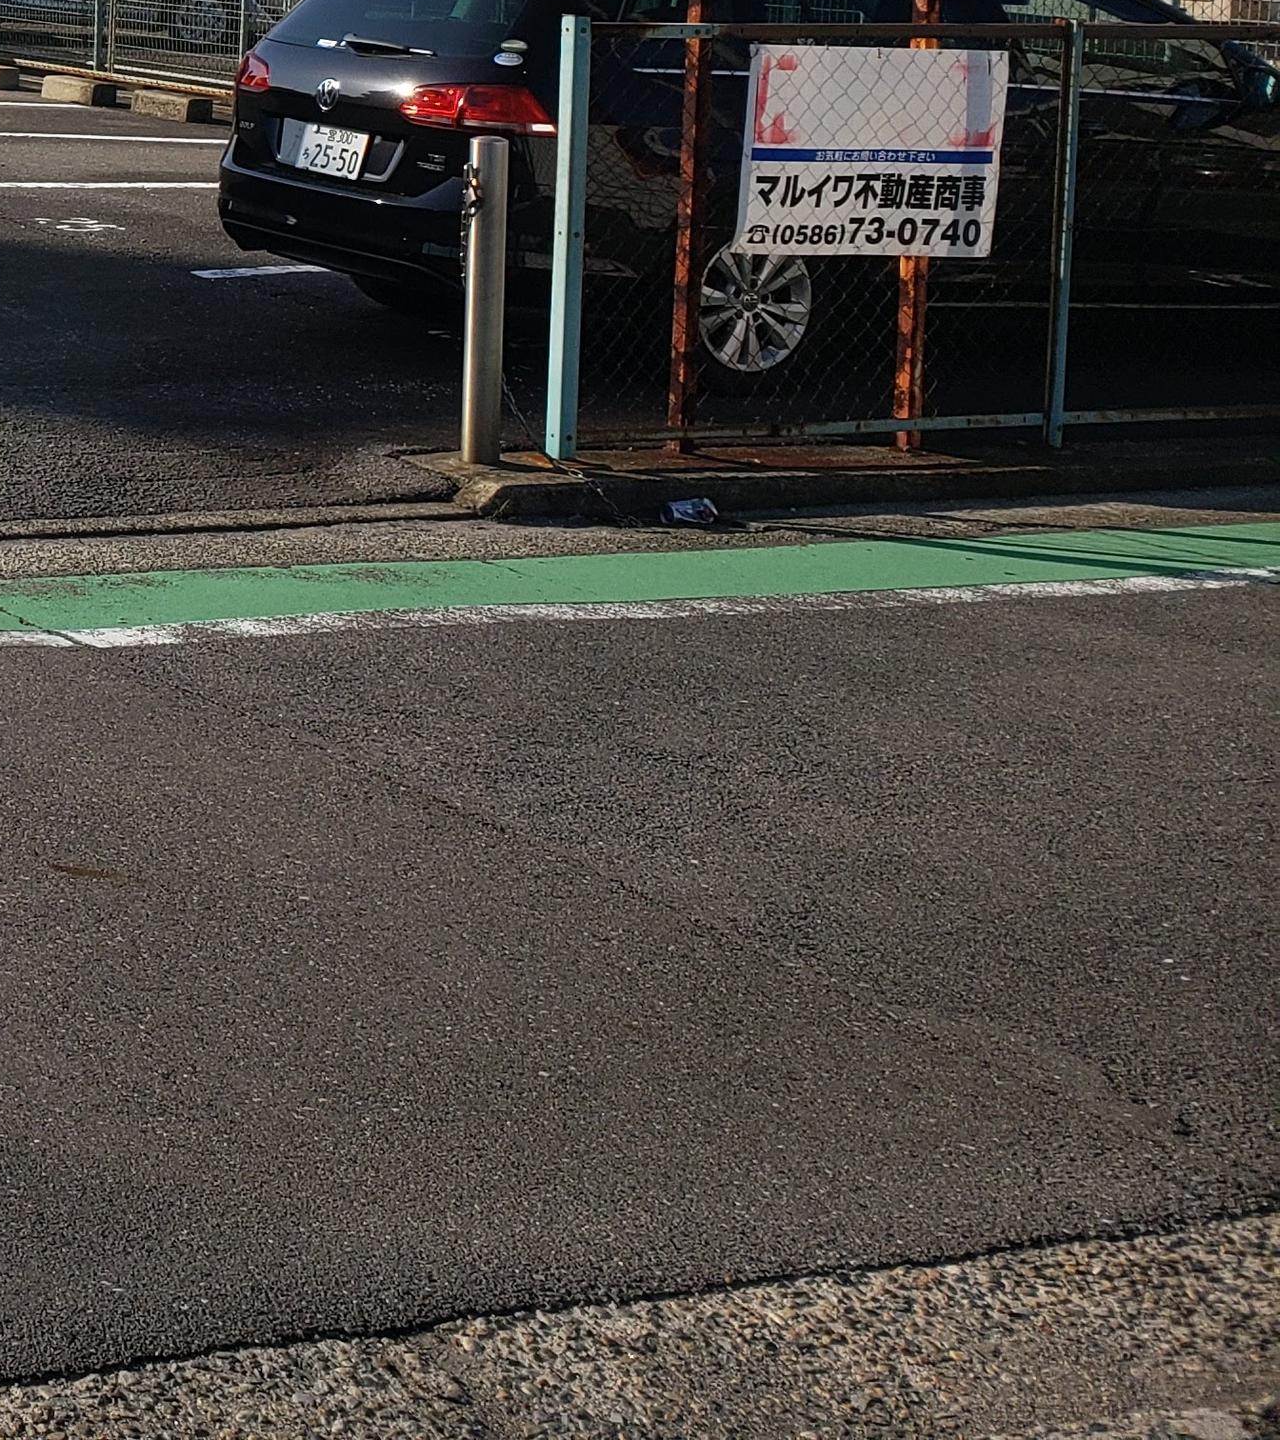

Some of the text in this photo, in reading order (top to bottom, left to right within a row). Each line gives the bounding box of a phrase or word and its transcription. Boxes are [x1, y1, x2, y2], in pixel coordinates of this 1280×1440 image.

[309, 143, 359, 174] 25-50
[815, 150, 936, 162] お気軽にお問い合わせ下さい
[755, 172, 987, 212] マルイワ不動産商事
[772, 217, 982, 247] (0586)73-0740
